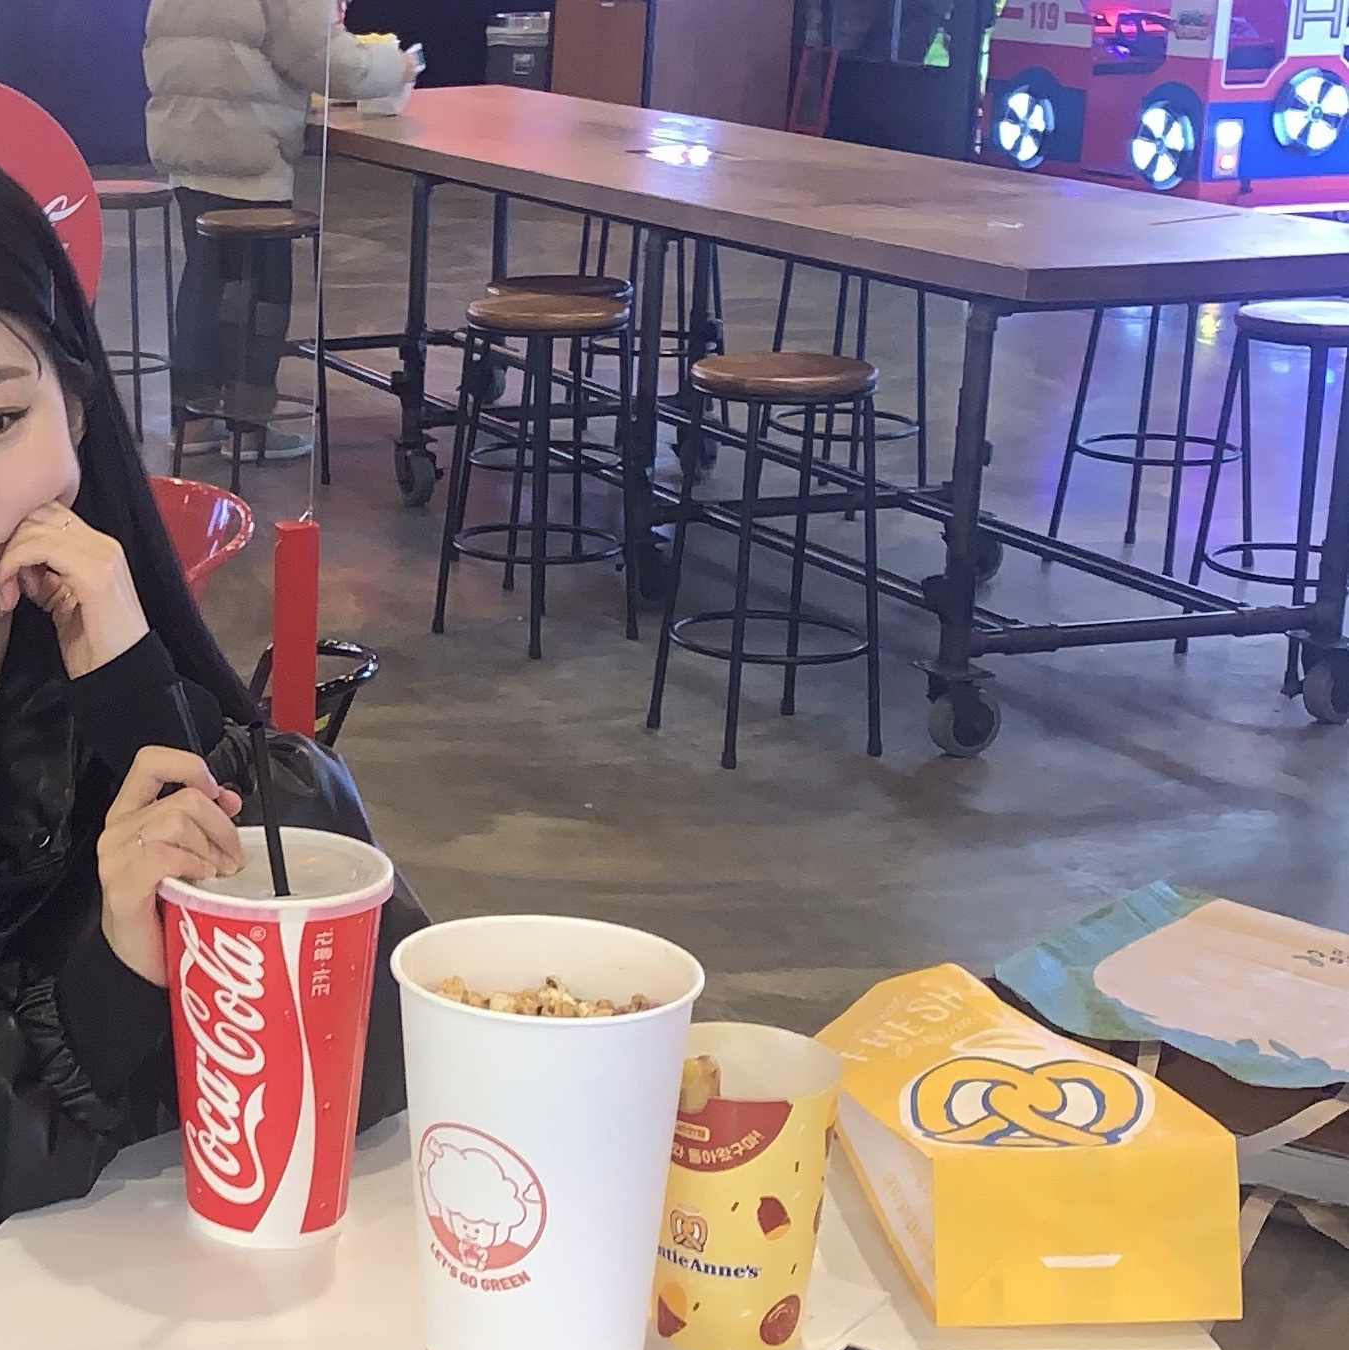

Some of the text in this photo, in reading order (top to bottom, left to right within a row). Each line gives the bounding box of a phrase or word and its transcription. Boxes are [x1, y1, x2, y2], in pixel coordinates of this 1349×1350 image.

[1030, 2, 1060, 31] 119
[180, 907, 266, 1205] Coca-Cola
[657, 1244, 689, 1268] ntie
[459, 1272, 478, 1289] GO
[480, 1270, 531, 1292] GREEN
